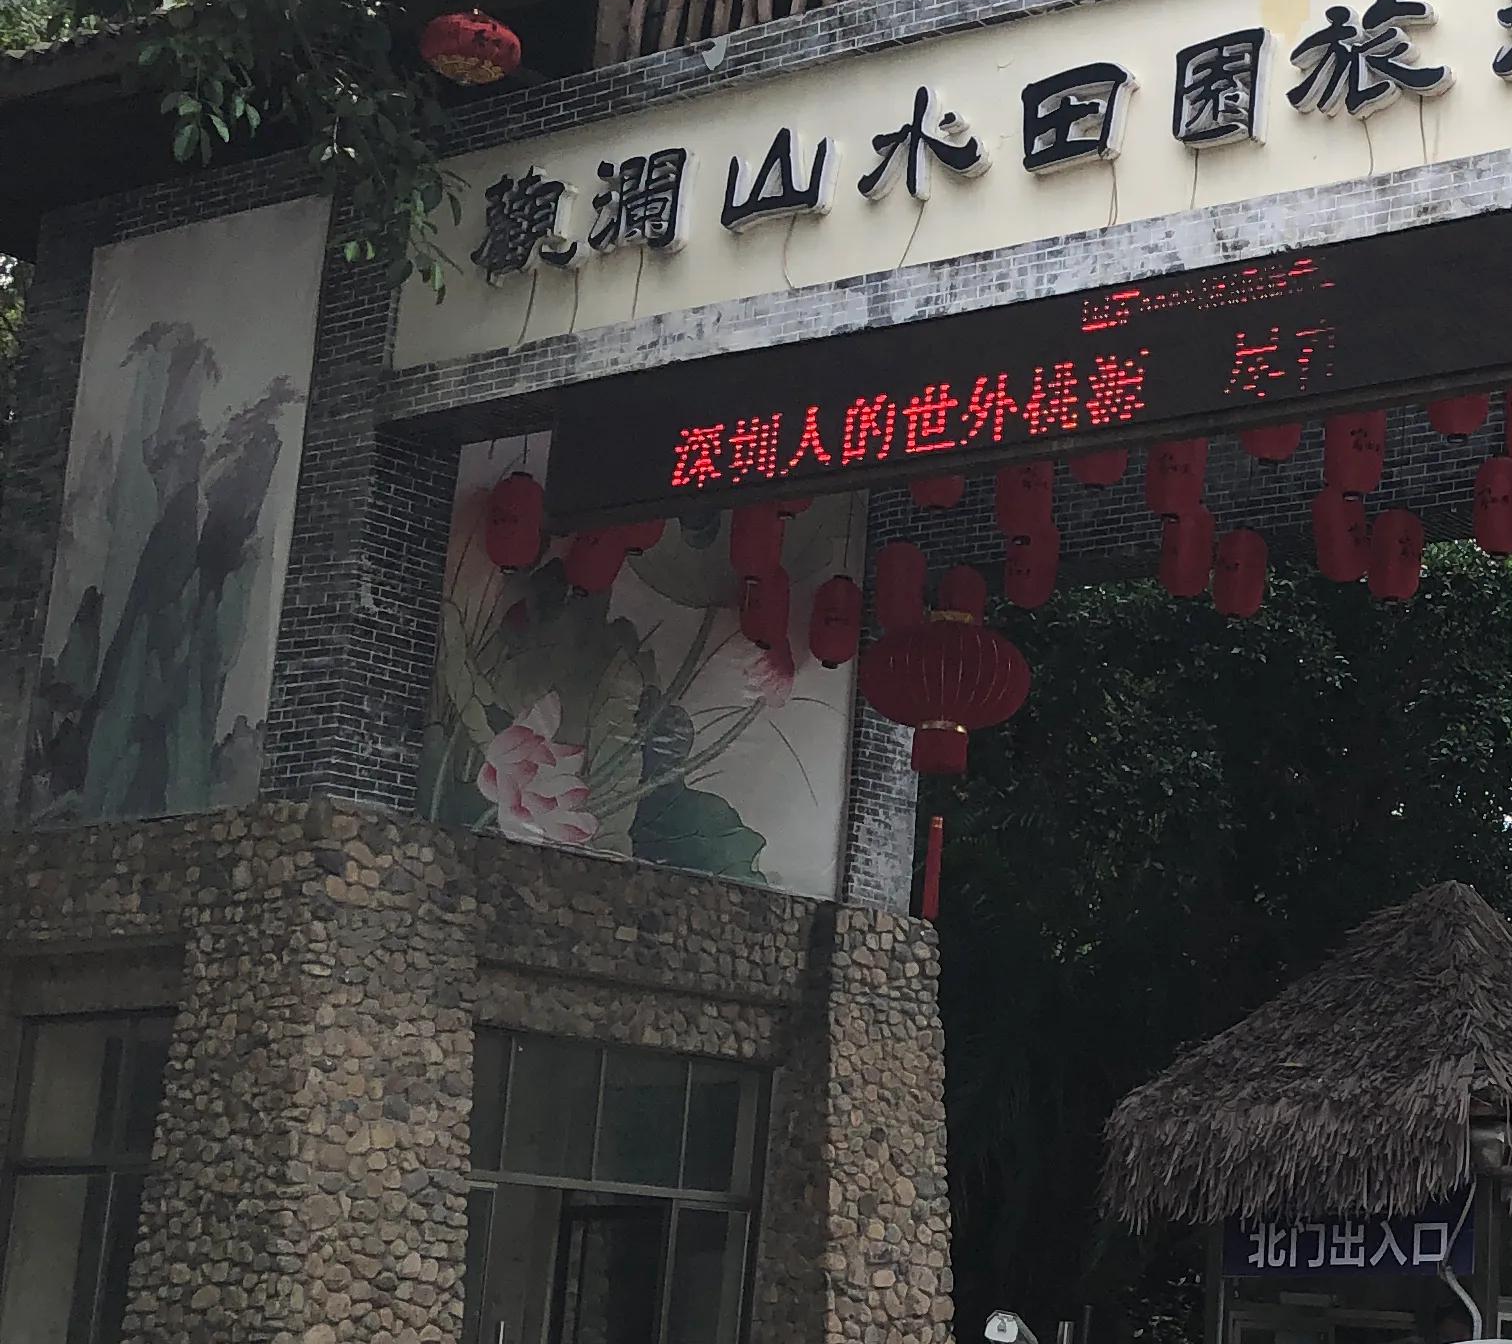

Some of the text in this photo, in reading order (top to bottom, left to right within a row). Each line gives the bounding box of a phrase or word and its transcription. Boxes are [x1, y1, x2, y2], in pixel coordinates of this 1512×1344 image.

[1248, 1221, 1448, 1268] 北门出入口
